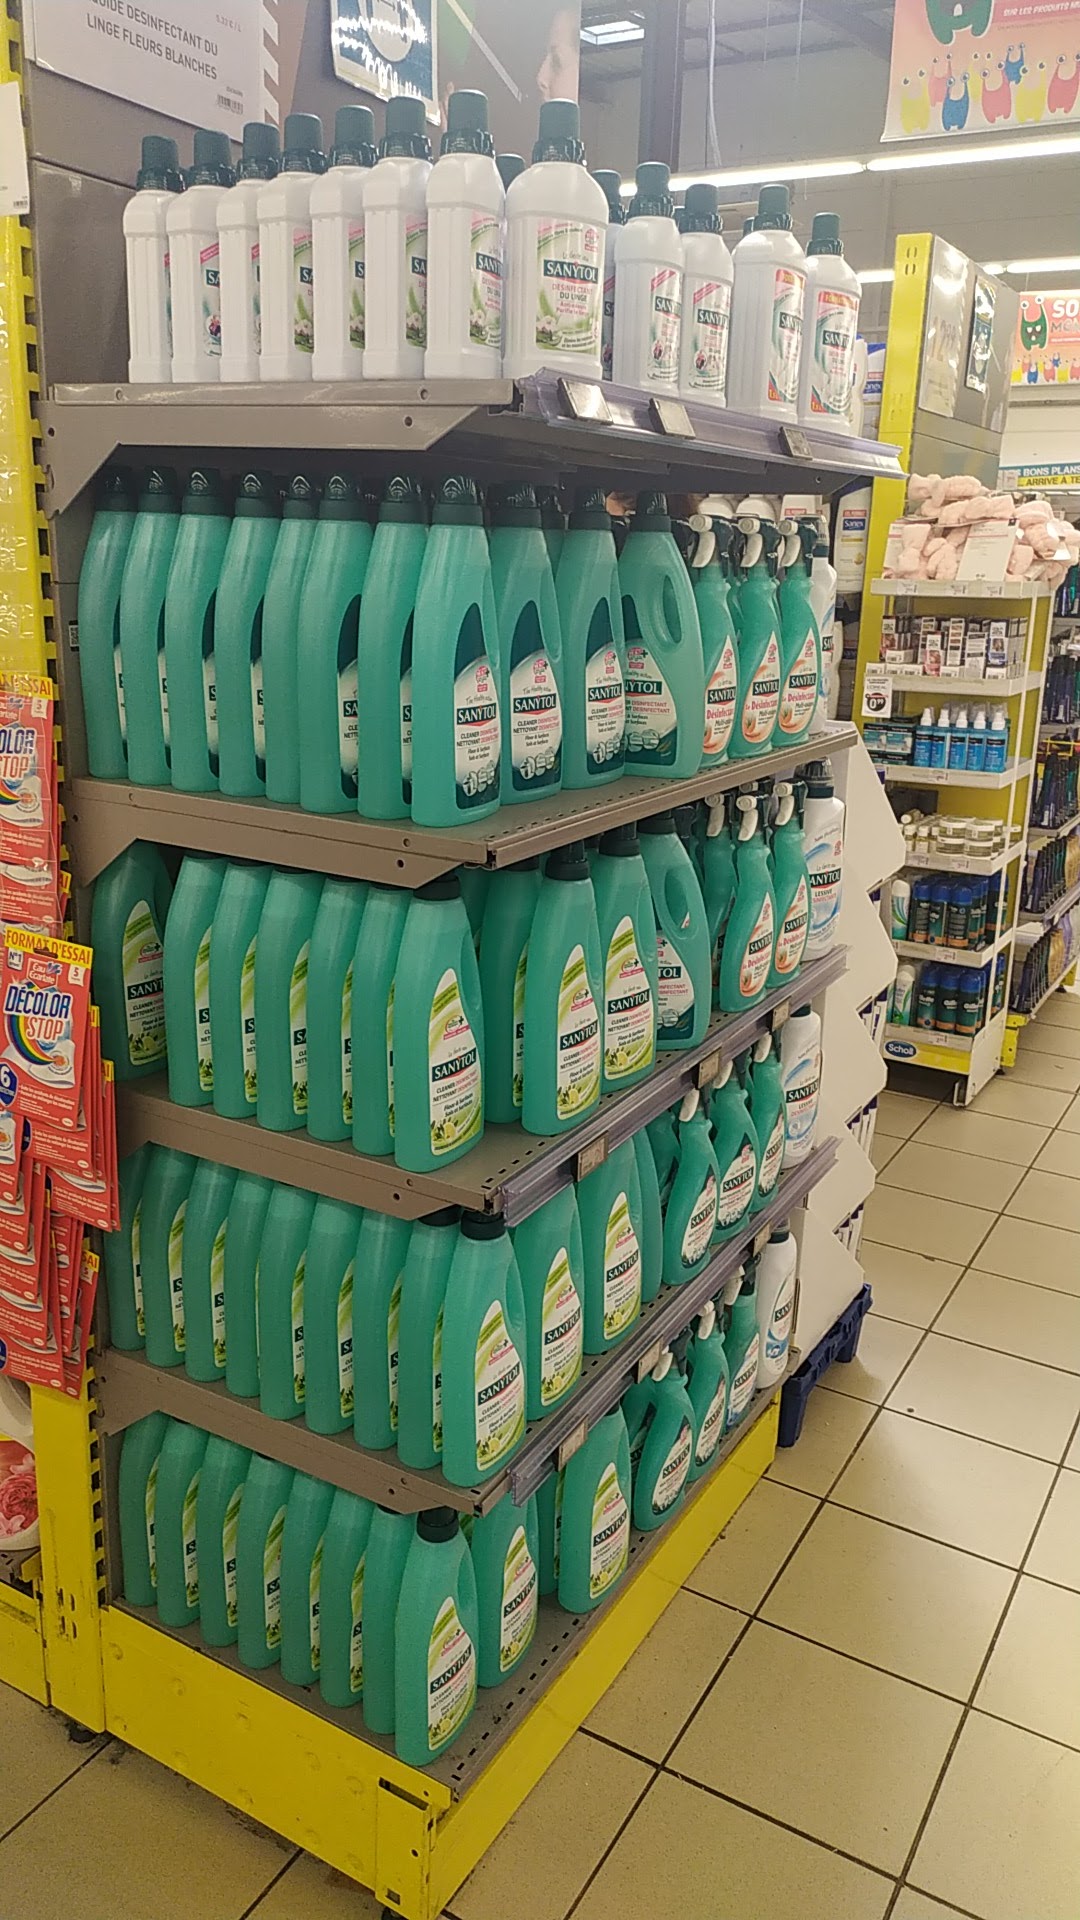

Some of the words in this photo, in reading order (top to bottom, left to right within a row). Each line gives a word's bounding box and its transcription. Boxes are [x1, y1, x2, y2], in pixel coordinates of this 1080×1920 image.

[1003, 8, 1018, 17] SUR
[126, 5, 202, 49] DESINFECTANT
[204, 40, 218, 56] DU
[87, 13, 120, 39] LINGE
[123, 29, 163, 57] FLEURS
[165, 47, 217, 80] BLANCHES
[478, 254, 502, 277] SANYT
[546, 262, 596, 282] SANYTOL
[560, 291, 570, 300] DU
[1023, 467, 1049, 477] BONS
[1051, 465, 1080, 475] PLANS
[1026, 477, 1058, 486] ARRIVE
[589, 685, 621, 701] SANYTOL
[625, 681, 660, 694] NYTOL
[754, 681, 779, 694] SANYTOL
[515, 695, 556, 712] SANYTOL
[458, 705, 496, 723] SANYTOL
[513, 726, 538, 734] NETTOYANT
[518, 719, 538, 727] CLEANER
[0, 728, 35, 755] OLOR
[457, 738, 480, 747] NETTOYANT
[461, 731, 480, 740] CLEANER
[810, 869, 840, 887] ANYTOL
[814, 889, 833, 898] LESSIVE
[6, 930, 48, 950] FORMAT
[51, 942, 91, 965] D'ESSAI
[32, 962, 46, 973] Eau
[73, 967, 80, 978] 5
[130, 981, 163, 998] SANYT
[5, 985, 72, 1019] DÉCOLOR
[609, 993, 649, 1013] SANYTOL
[26, 1017, 64, 1041] STOP
[611, 1016, 629, 1026] CLEANER
[562, 1022, 598, 1049] SANYTOL
[888, 1044, 914, 1055] Scholl
[434, 1051, 474, 1080] SANYTOL
[432, 1088, 457, 1103] NETTOYANT
[436, 1082, 456, 1094] CLEANER
[608, 1254, 638, 1281] SANYTOL
[547, 1312, 579, 1343] SANYTOL
[480, 1369, 518, 1402] SANYTOL
[432, 1648, 471, 1691] SANYTOL
